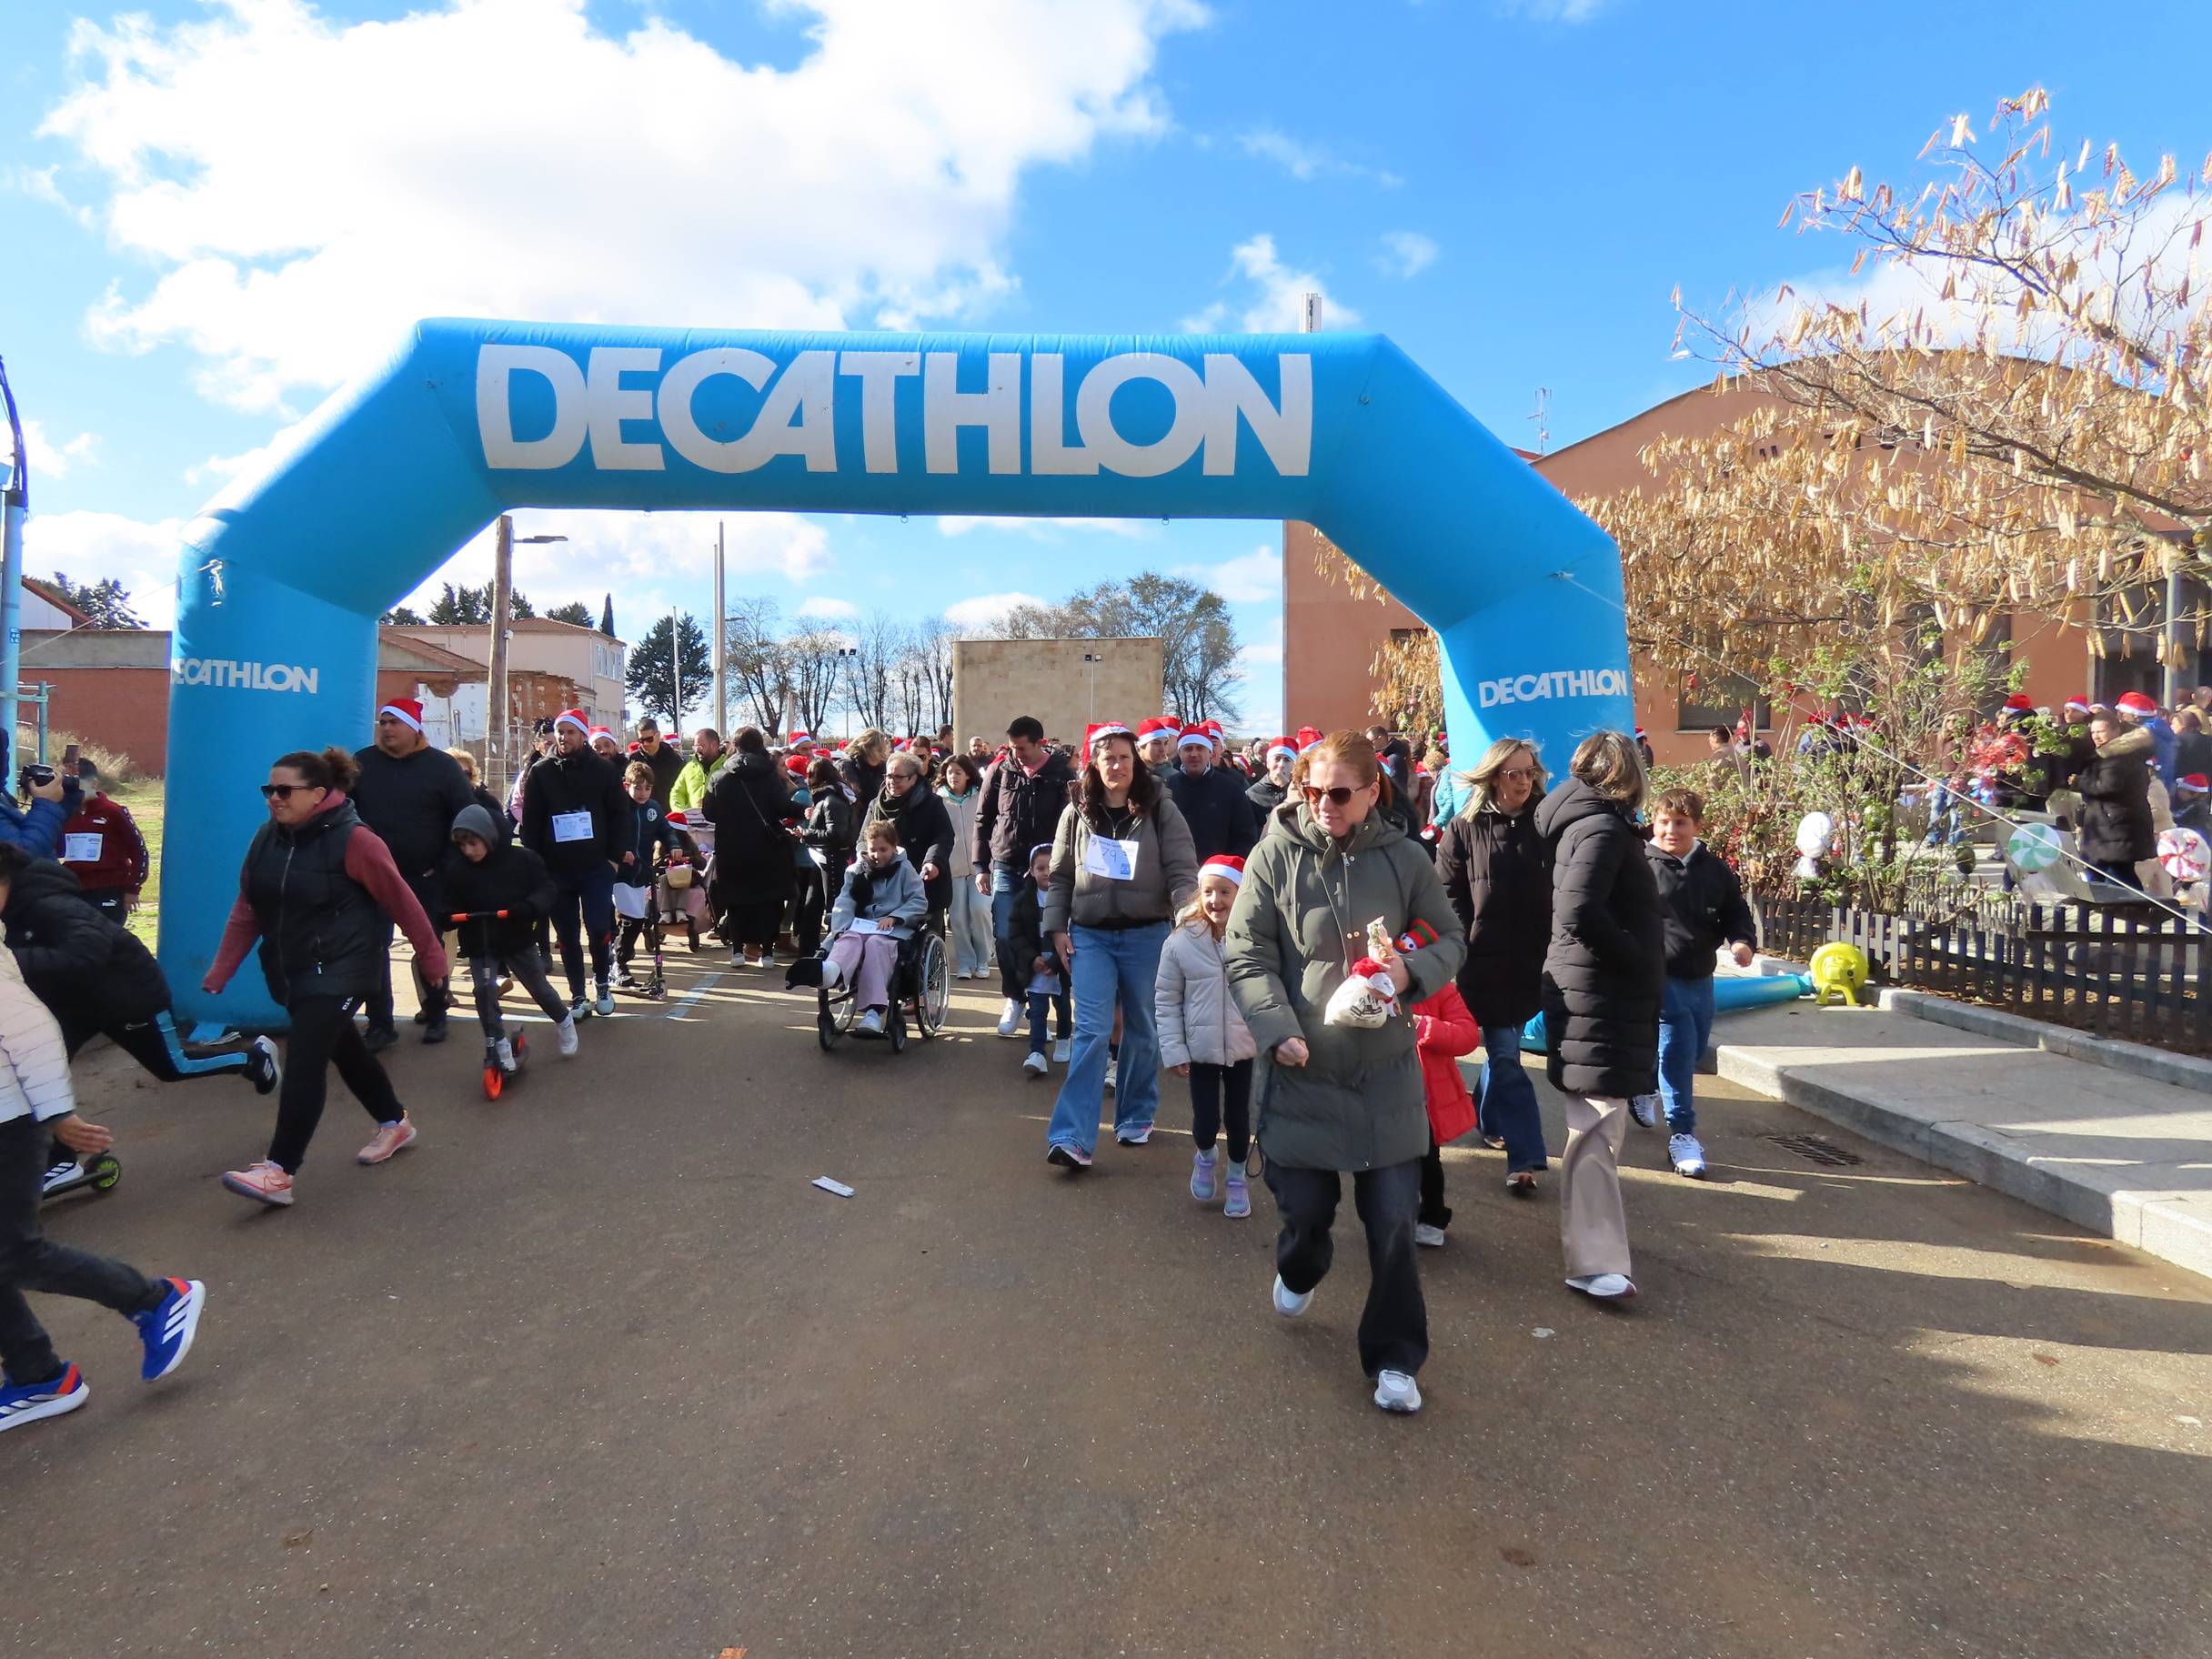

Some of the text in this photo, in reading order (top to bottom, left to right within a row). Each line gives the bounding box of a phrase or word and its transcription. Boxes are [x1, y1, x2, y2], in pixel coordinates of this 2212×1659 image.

[476, 344, 1313, 478] DECATHLON
[170, 658, 318, 694] ECATHLON
[1478, 669, 1628, 708] DECATHLON
